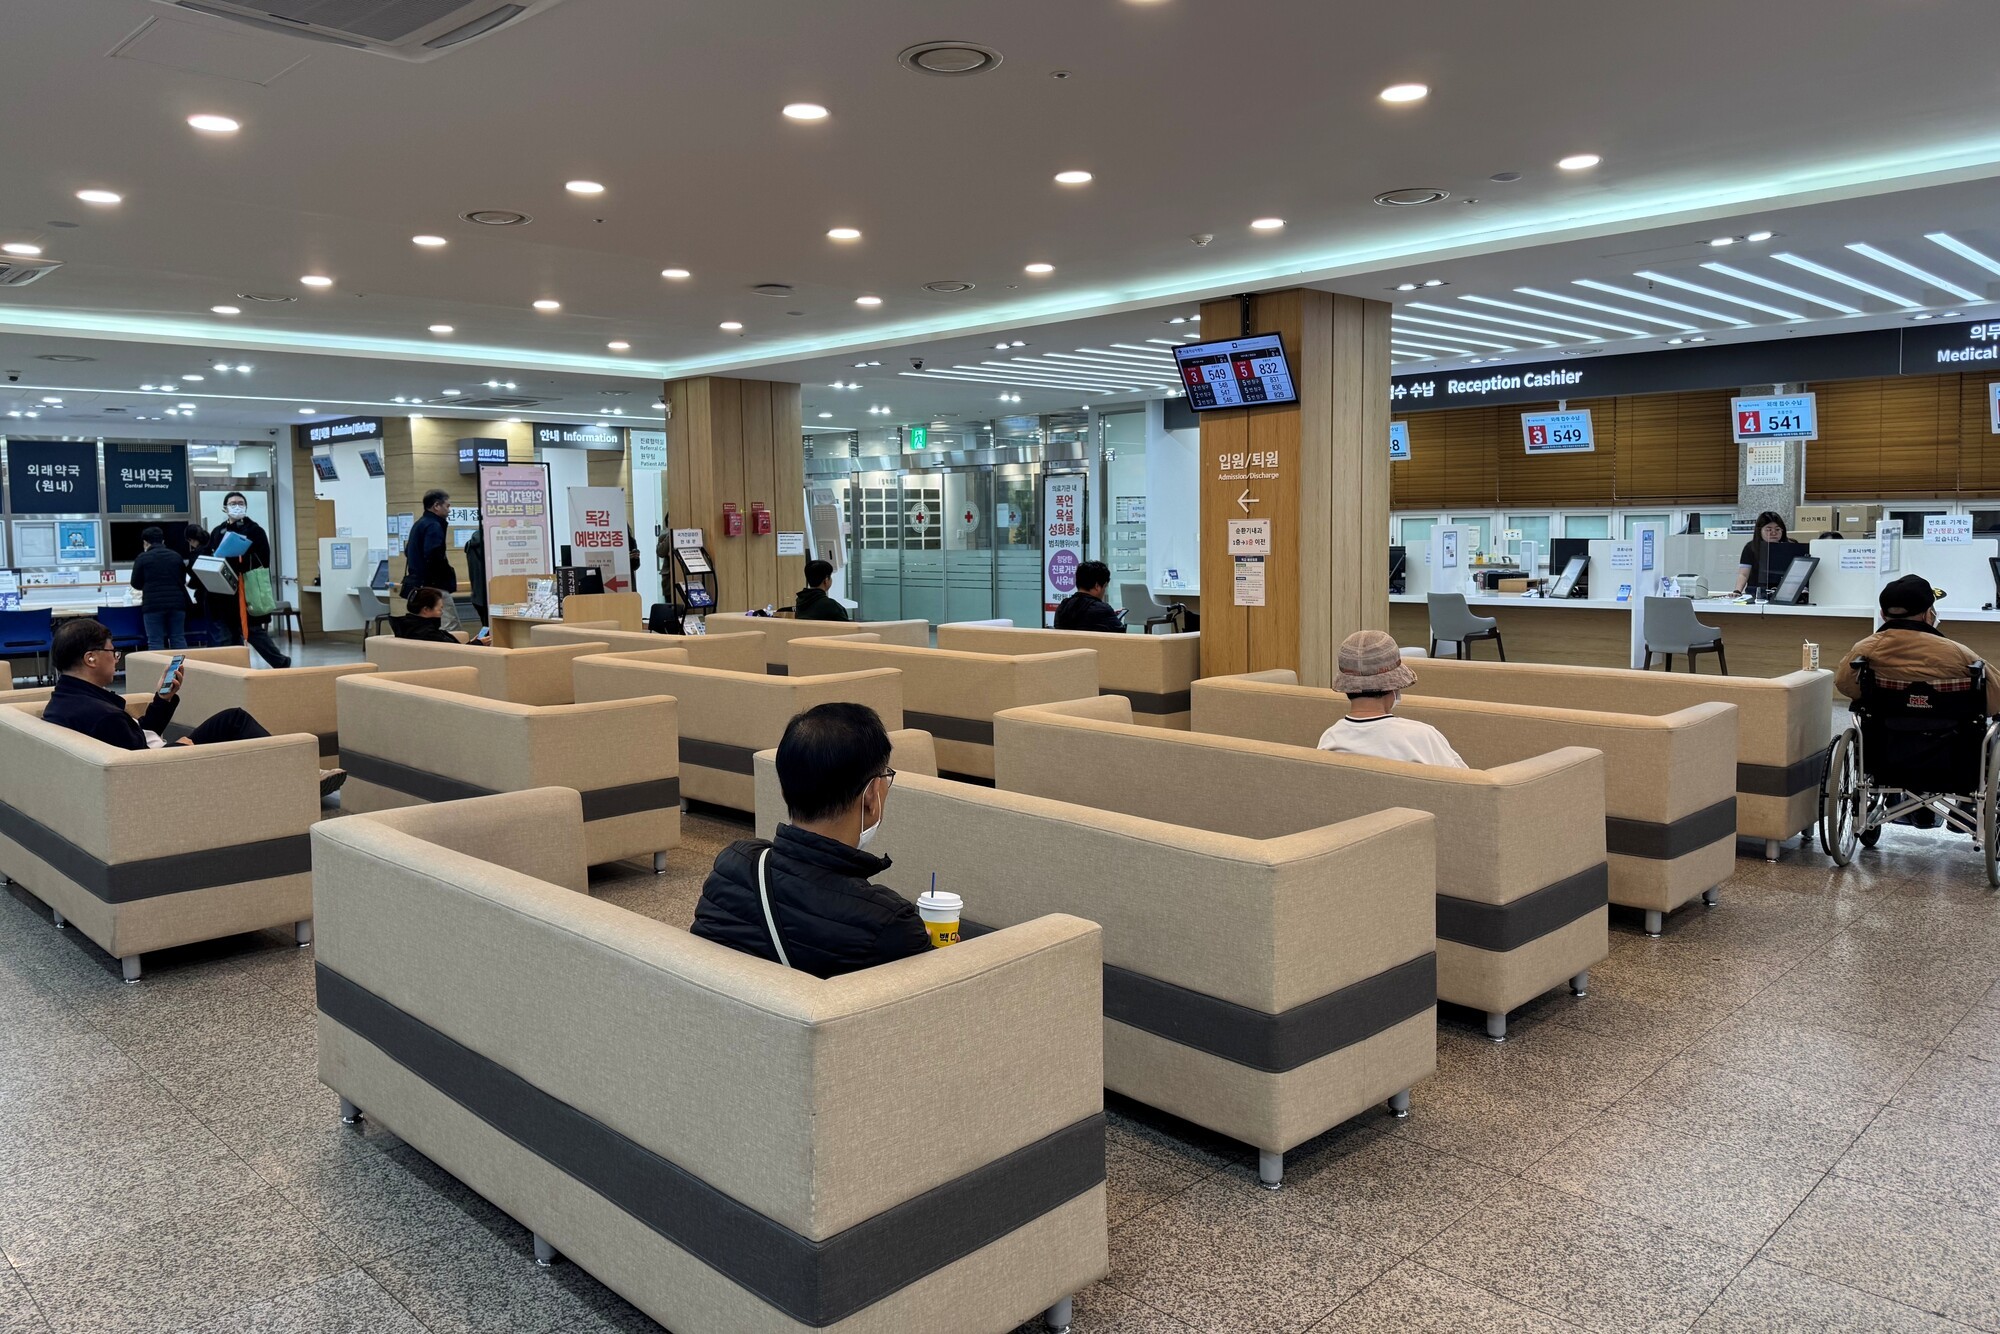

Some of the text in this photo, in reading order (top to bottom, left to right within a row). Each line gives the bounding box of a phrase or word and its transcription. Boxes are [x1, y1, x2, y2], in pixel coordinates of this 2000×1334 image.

[1937, 345, 1998, 363] Medical
[1190, 368, 1227, 383] 3 549
[1240, 362, 1278, 377] 5 832
[1410, 380, 1435, 398] 수납
[1448, 374, 1521, 394] Reception
[1523, 369, 1583, 389] Cashier
[1744, 415, 1801, 432] 4 541
[540, 429, 618, 443] 안내 Information
[1532, 429, 1582, 444] 3 549
[1390, 439, 1400, 451] 8
[1218, 450, 1279, 471] 입원/퇴원
[27, 464, 81, 477] 외래약국
[120, 468, 174, 482] 원내약국
[1217, 471, 1280, 481] Admission/Discharge
[35, 479, 74, 493] (원내)
[1051, 484, 1077, 492] 의료기관 내
[1056, 494, 1073, 508] 폭언
[585, 510, 610, 527] 독감
[1056, 508, 1074, 522] 욕설
[1048, 522, 1080, 536] 성희롱은
[1235, 527, 1263, 535] 순환기내과
[574, 530, 624, 548] 예방접종
[1254, 538, 1266, 546] 이전
[1056, 555, 1073, 564] 정당한
[1051, 565, 1077, 575] 진료거부
